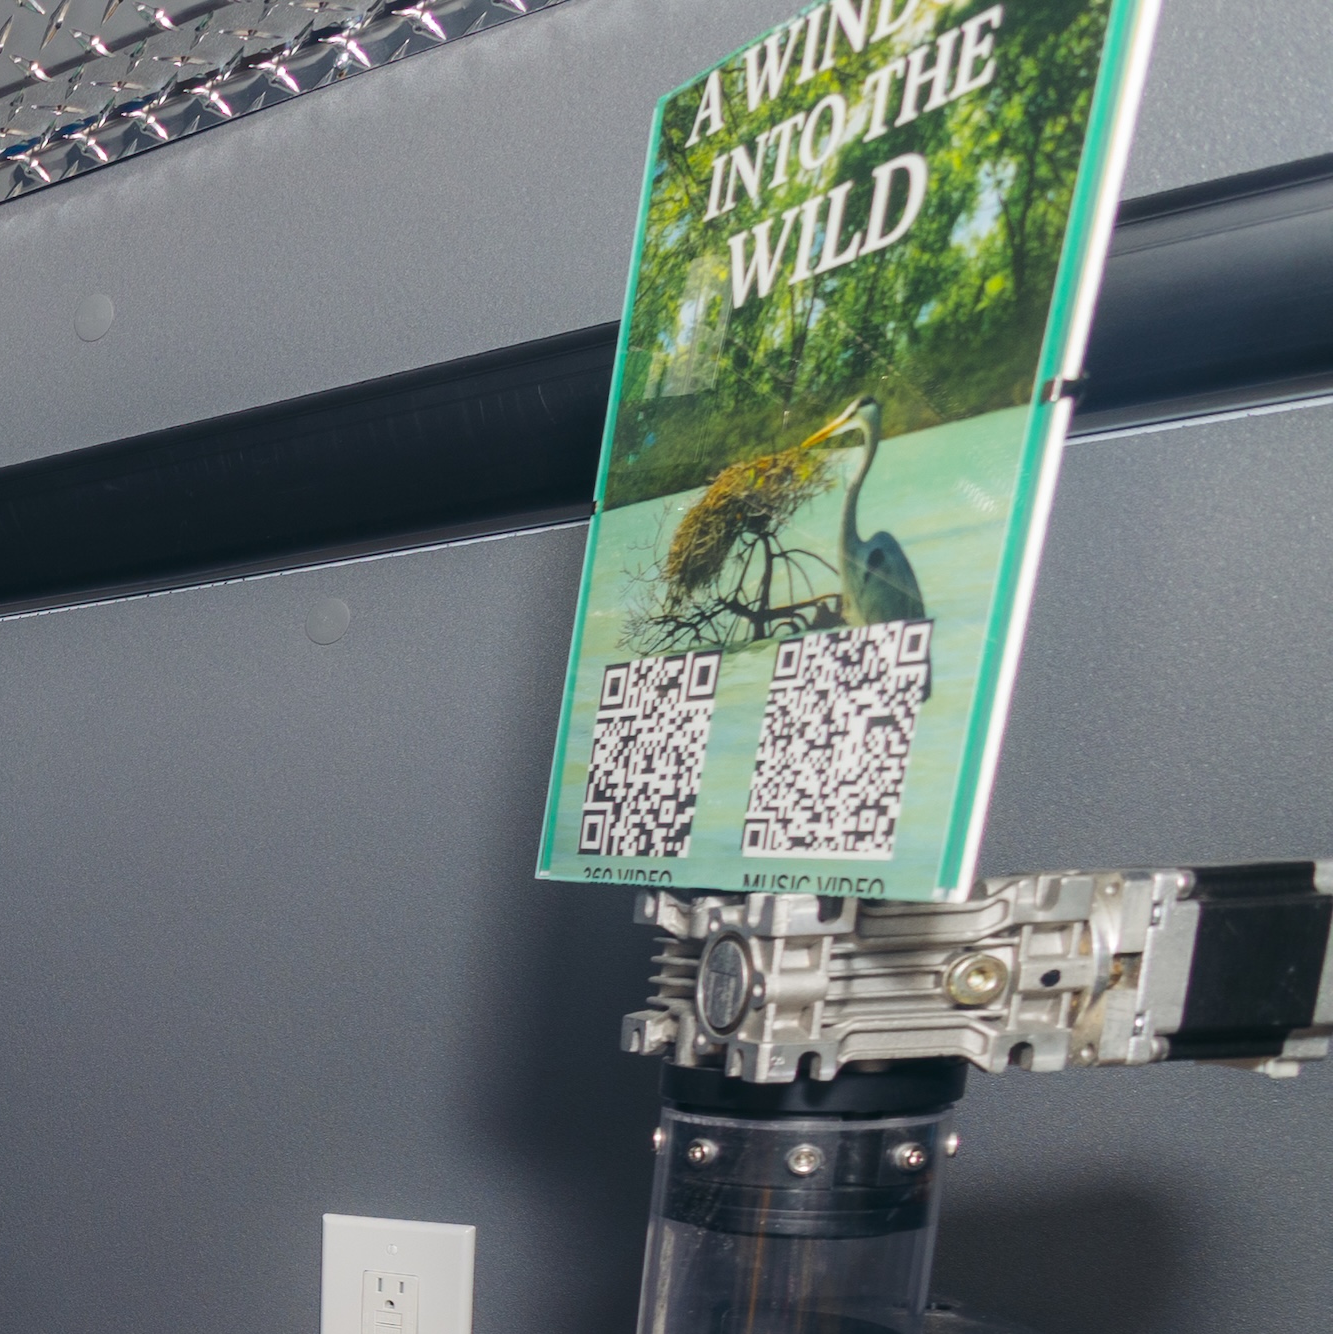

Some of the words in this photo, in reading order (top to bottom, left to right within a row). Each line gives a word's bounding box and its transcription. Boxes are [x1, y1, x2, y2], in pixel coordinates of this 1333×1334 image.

[684, 69, 725, 149] A
[742, 0, 955, 112] WIND
[703, 93, 847, 222] INTO
[862, 4, 1004, 141] THE
[727, 152, 930, 310] WILD
[617, 868, 673, 883] VIDEO
[743, 873, 811, 890] MUSIC
[817, 876, 885, 894] VIDEO
